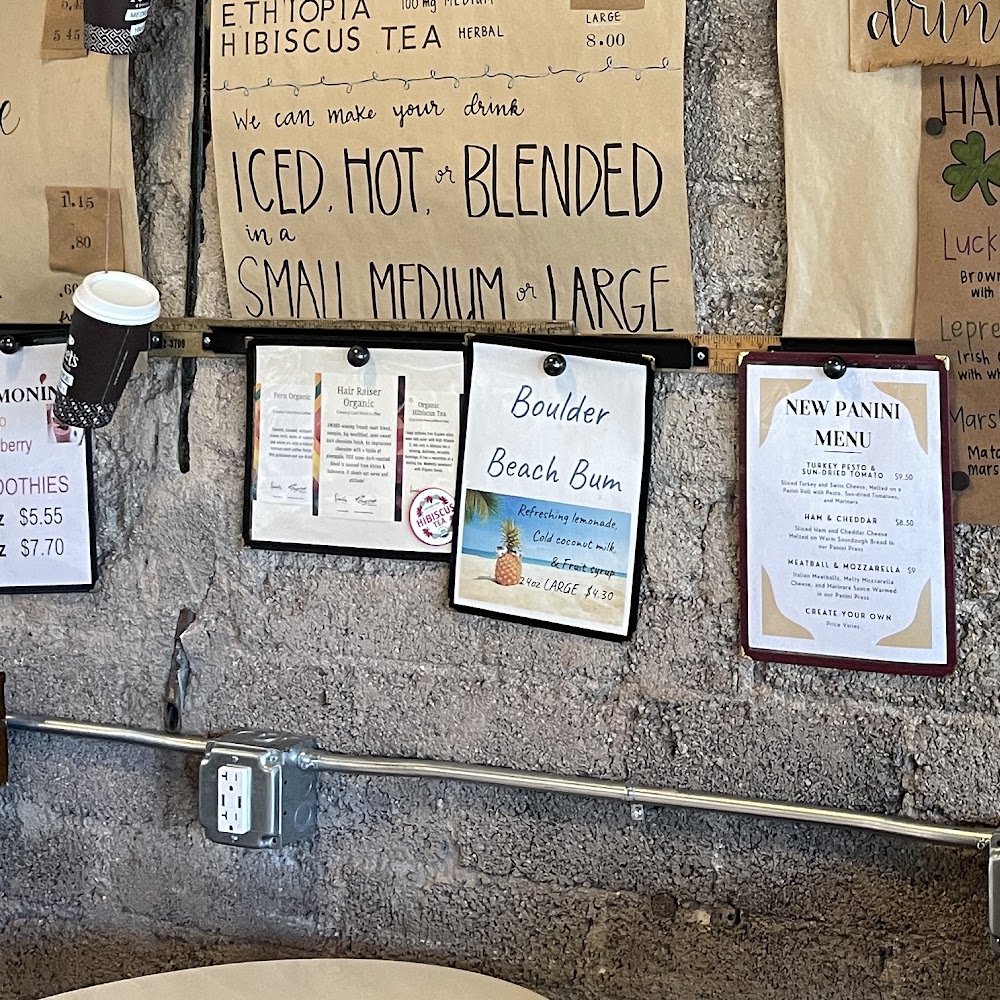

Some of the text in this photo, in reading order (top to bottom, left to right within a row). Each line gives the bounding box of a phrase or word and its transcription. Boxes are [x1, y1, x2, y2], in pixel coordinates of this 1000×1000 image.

[586, 12, 621, 24] LARGE
[222, 25, 504, 57] HIBISCUS HERBAL
[233, 93, 524, 130] We can make your drink
[435, 142, 662, 217] or BLENDED
[246, 224, 272, 246] in
[517, 281, 536, 300] or
[957, 350, 990, 364] Irish
[337, 386, 381, 396] Hair Raiser
[344, 398, 374, 408] Organic
[418, 402, 439, 410] Organic
[511, 385, 609, 424] Boulder
[786, 399, 900, 420] NEW PANINI
[815, 430, 871, 448] MENU
[487, 447, 559, 483] Beach
[802, 468, 884, 479] SUN-DRIED TOMATO
[806, 461, 837, 470] TURKEY
[20, 508, 63, 526] $5.55
[416, 503, 455, 528] HIBISCUS
[433, 518, 446, 528] TEA
[518, 505, 568, 524] Refreshing
[837, 515, 877, 524] CHEDDAR
[556, 536, 592, 549] coconut
[561, 558, 615, 579] Fruit syrup
[788, 559, 900, 573] MEATBALL MOZZARELLA
[544, 576, 613, 601] LARGE $4.30
[869, 612, 891, 621] OWN
